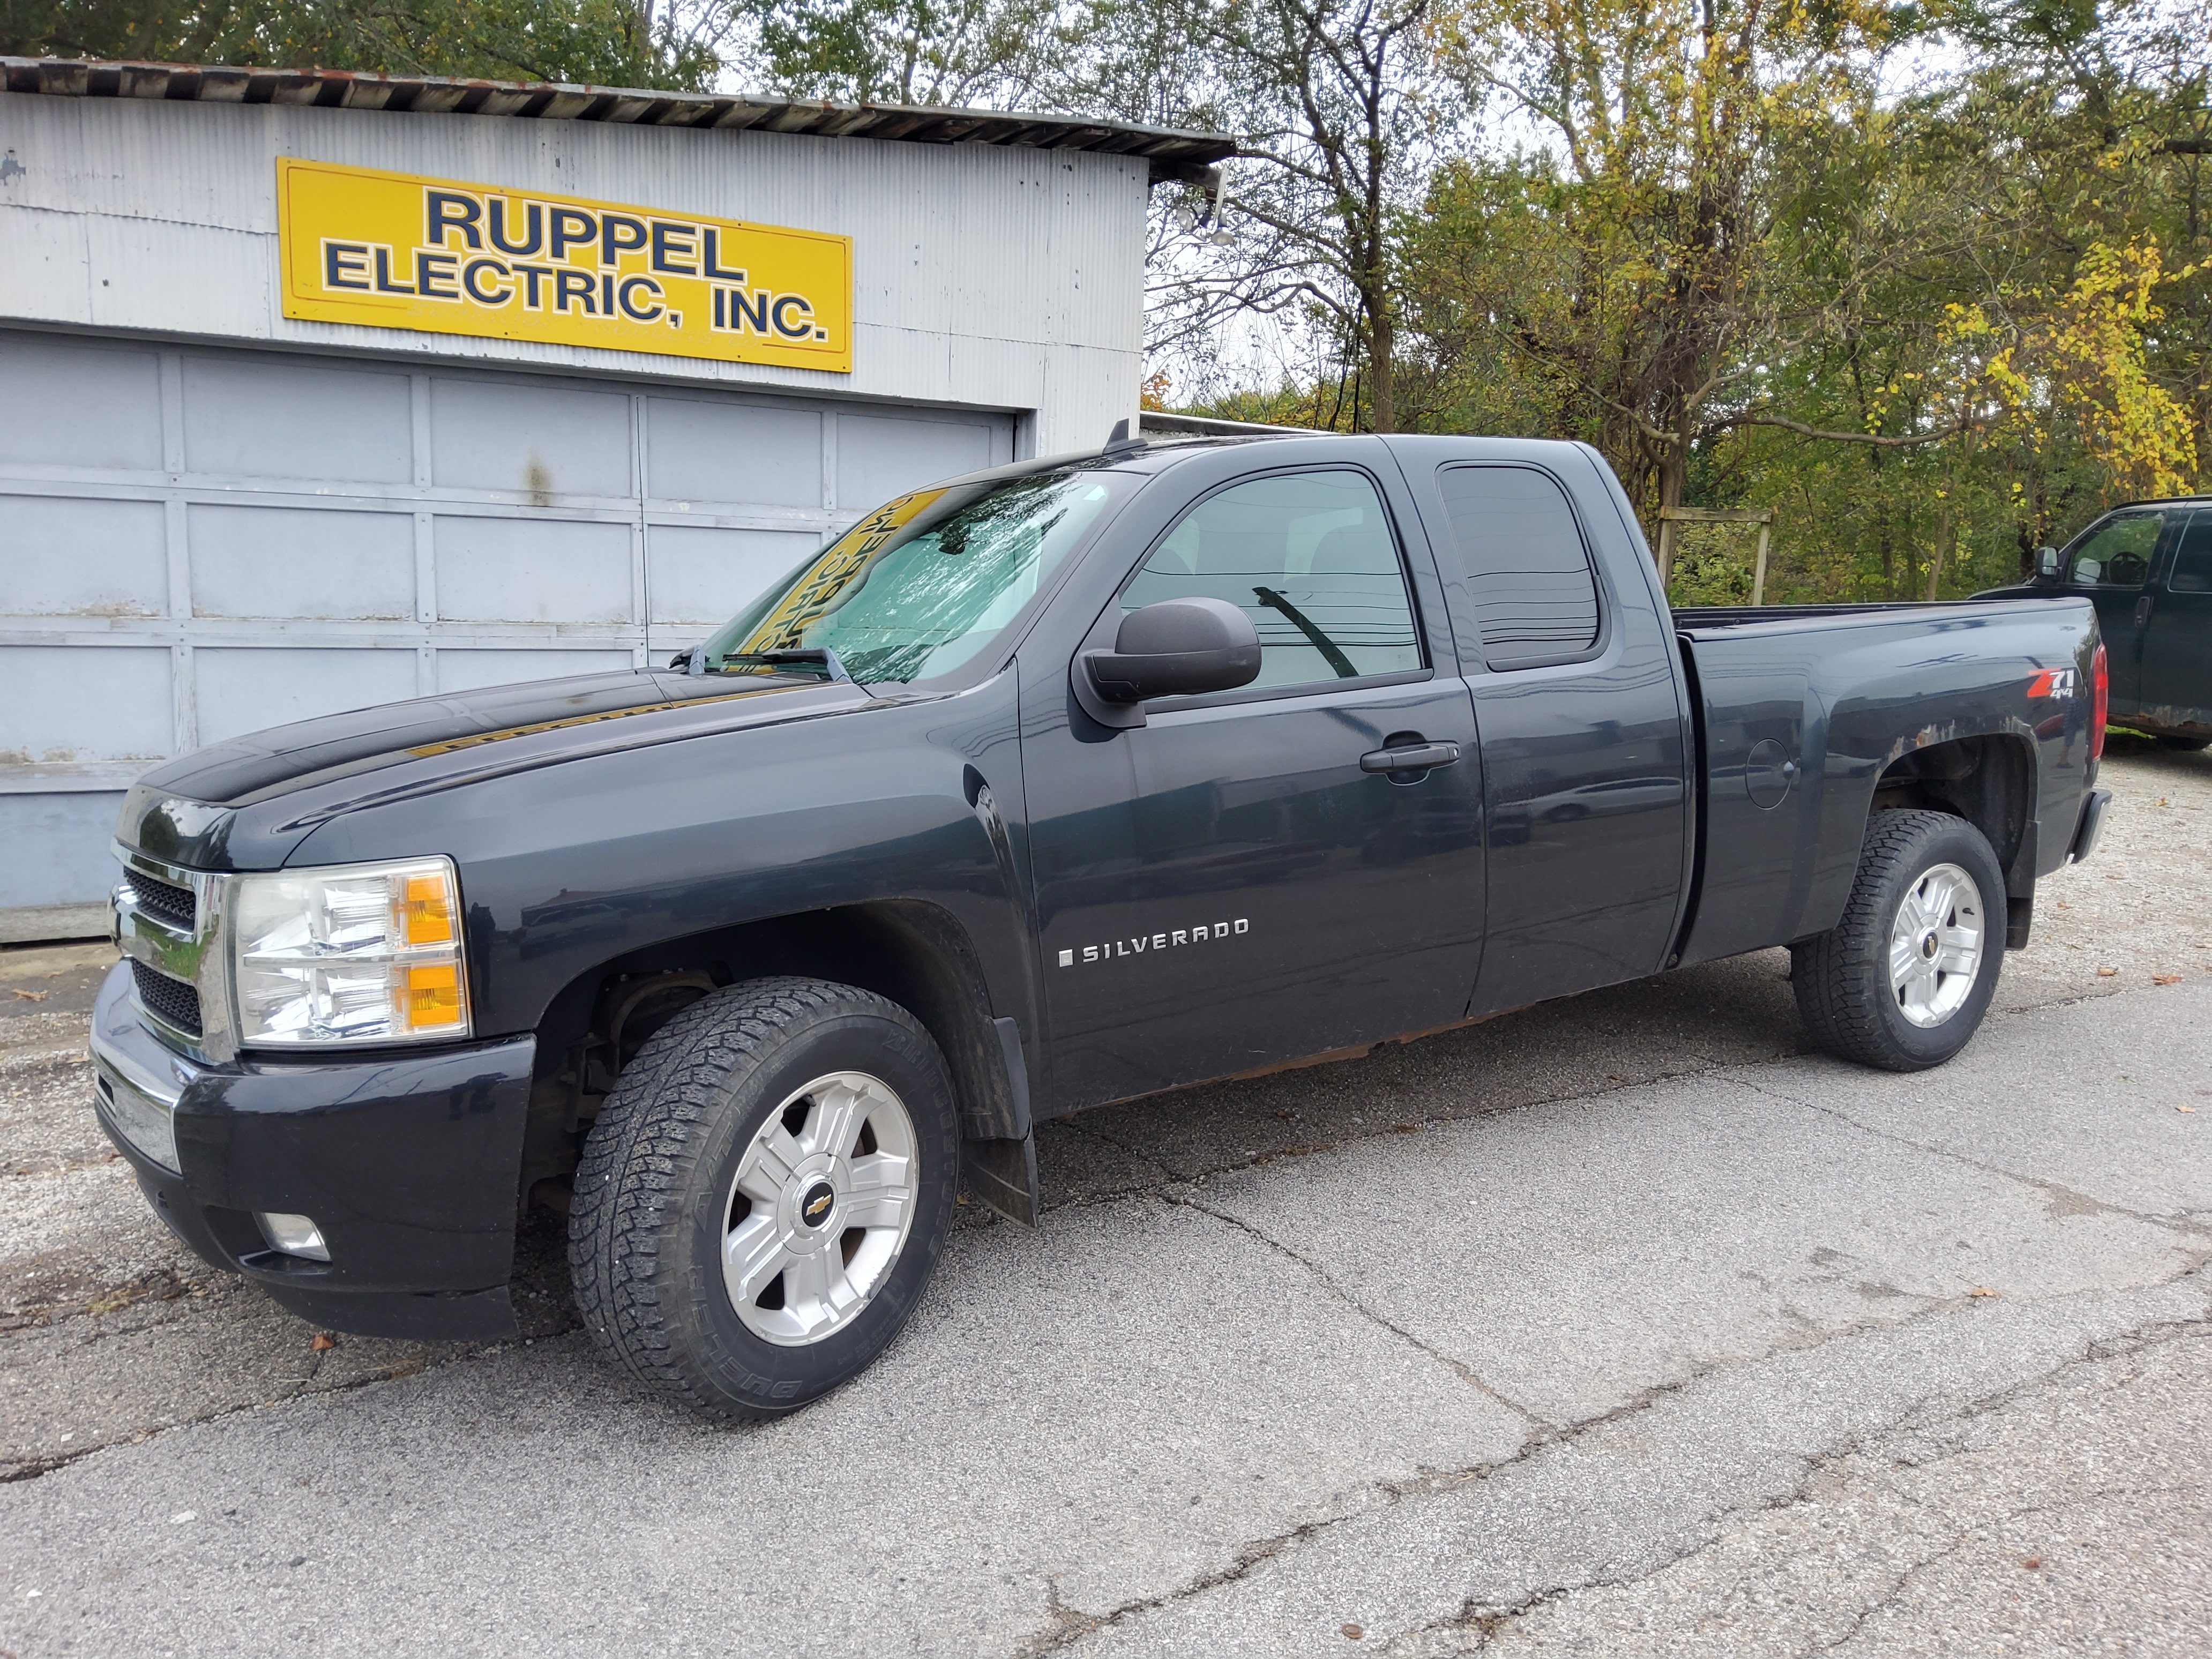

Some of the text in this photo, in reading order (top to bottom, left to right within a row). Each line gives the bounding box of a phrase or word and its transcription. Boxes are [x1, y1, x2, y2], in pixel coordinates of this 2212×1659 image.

[425, 188, 746, 283] RUPPEL
[323, 240, 827, 341] ELECTRIC, INC.
[1083, 918, 1249, 962] SILVERADO
[689, 1265, 803, 1399] DUELER
